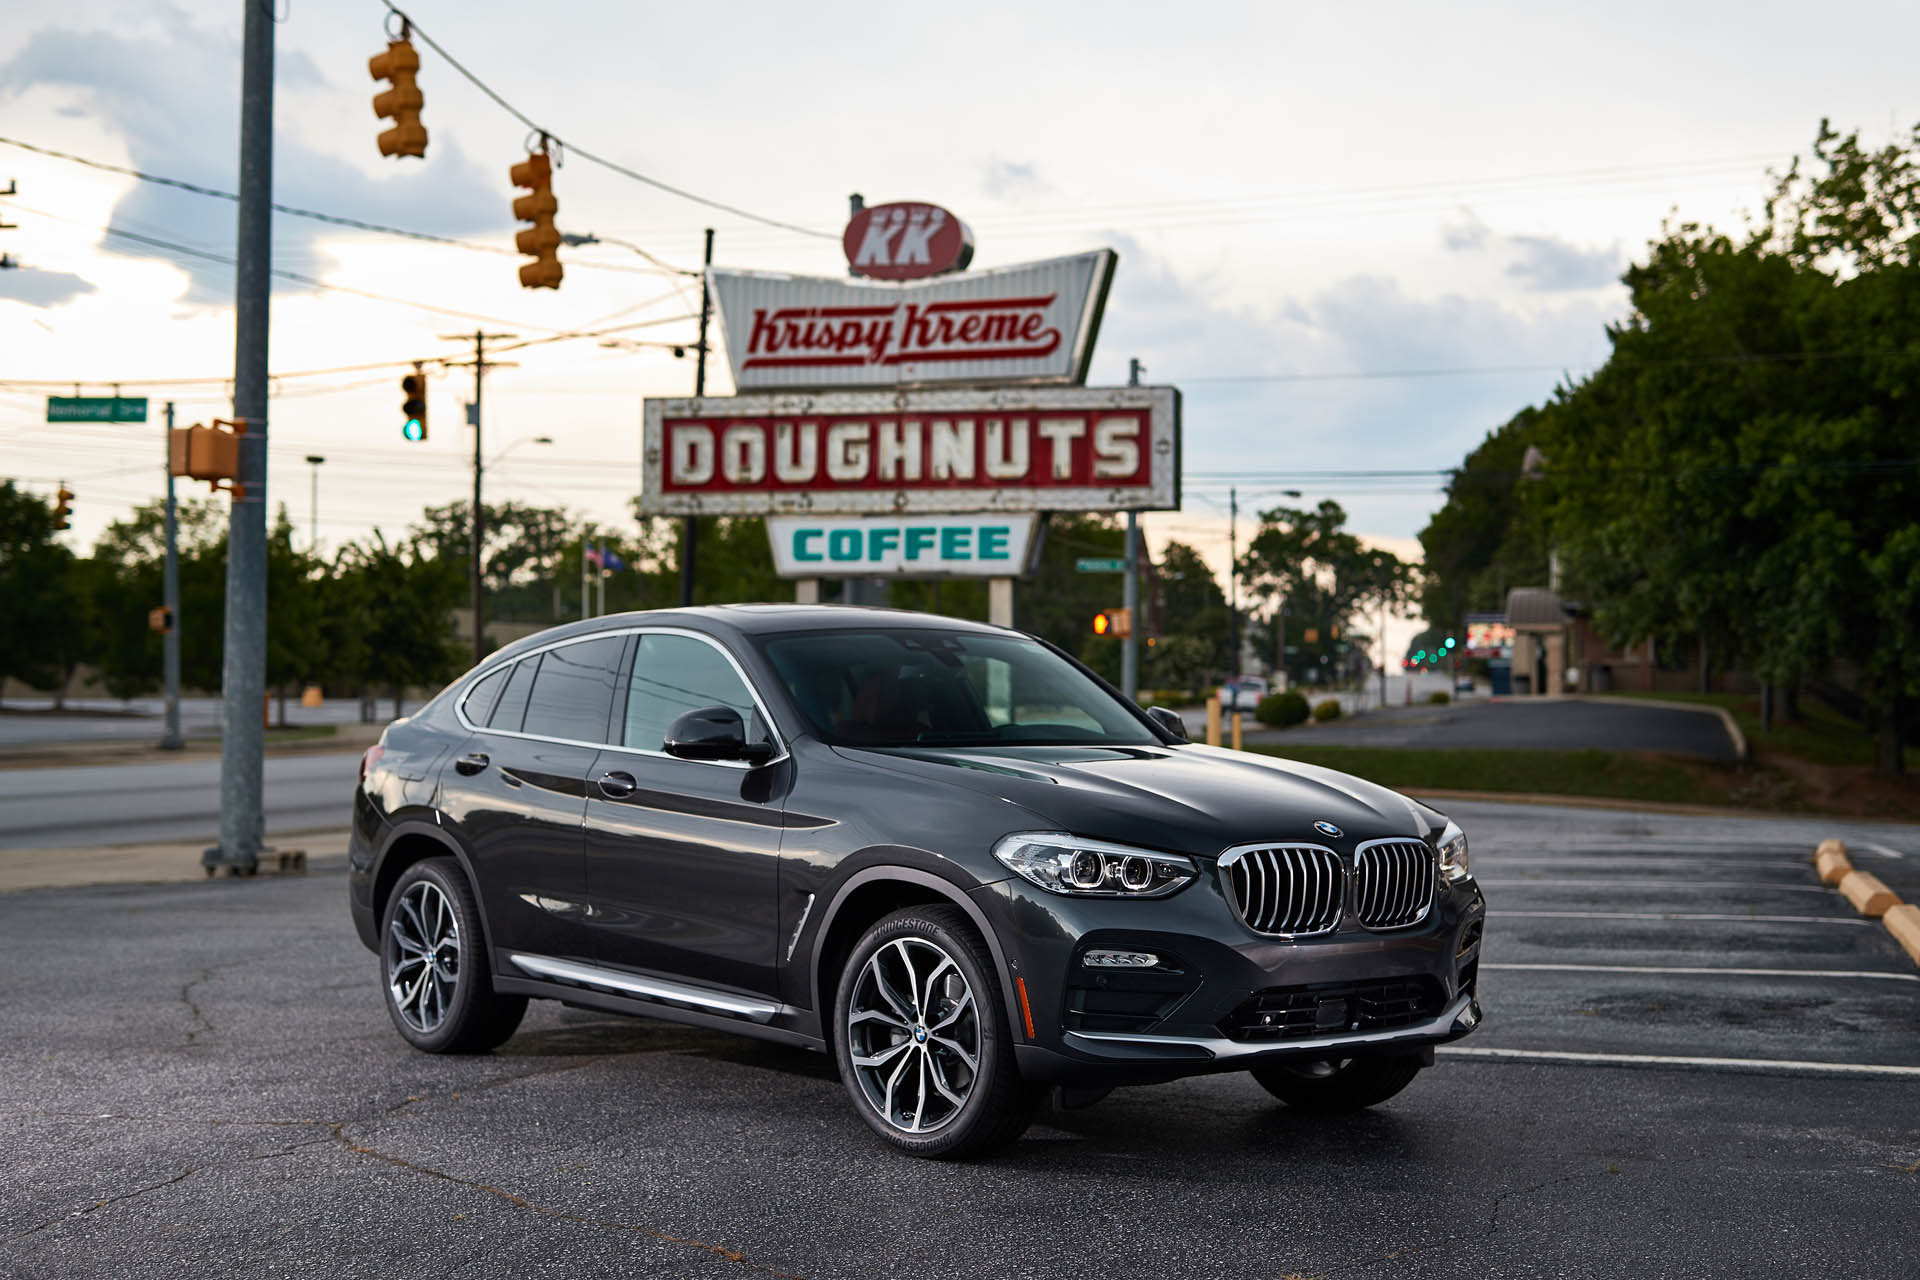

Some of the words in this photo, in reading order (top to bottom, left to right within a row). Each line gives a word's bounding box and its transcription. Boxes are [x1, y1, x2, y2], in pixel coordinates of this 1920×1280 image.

[855, 208, 945, 266] KK
[747, 303, 899, 363] Krispy
[900, 294, 1061, 358] Kreme
[672, 417, 1141, 484] DOUGHNUTS
[793, 526, 1010, 562] COFFEE
[873, 918, 940, 940] BRIDGESTONE
